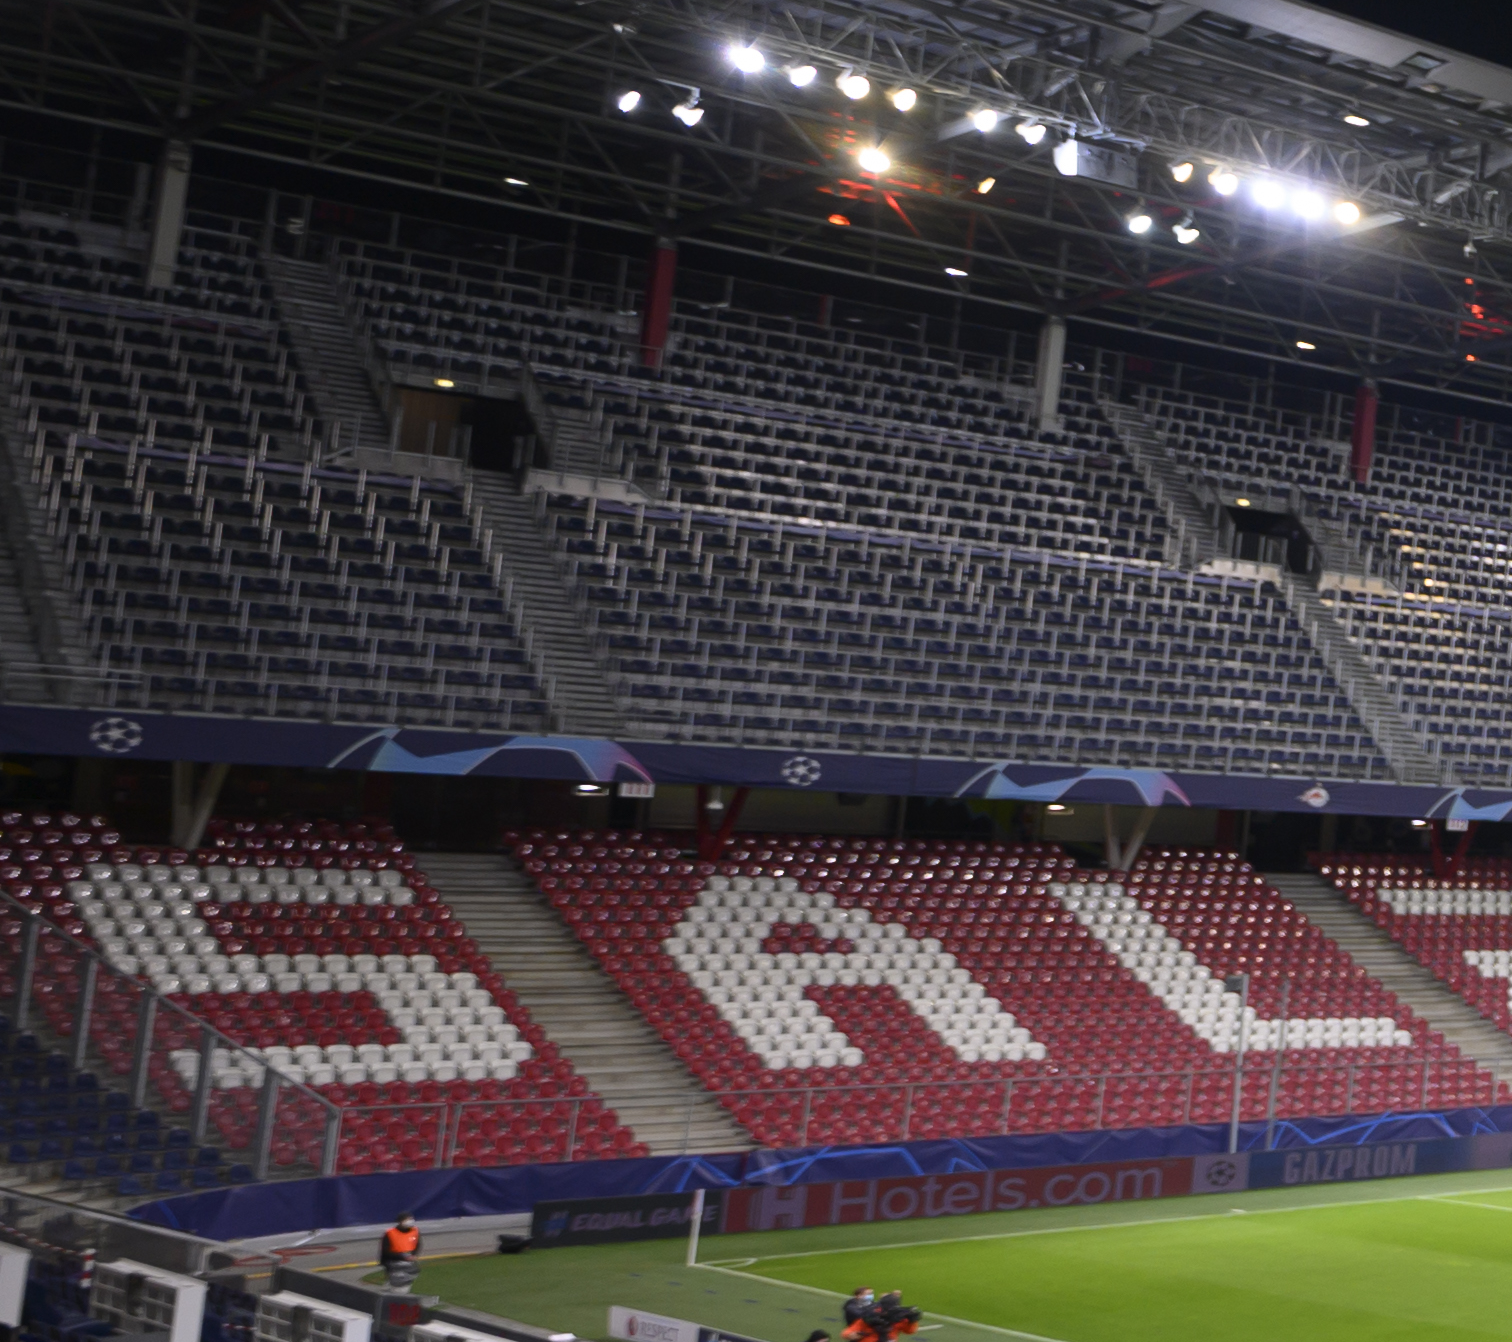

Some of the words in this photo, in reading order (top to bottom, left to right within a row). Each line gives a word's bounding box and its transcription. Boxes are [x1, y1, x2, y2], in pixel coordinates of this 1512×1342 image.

[1284, 1143, 1418, 1184] GAZPROM
[831, 1165, 1164, 1225] Hotels.com
[640, 1321, 680, 1342] RESPECT
